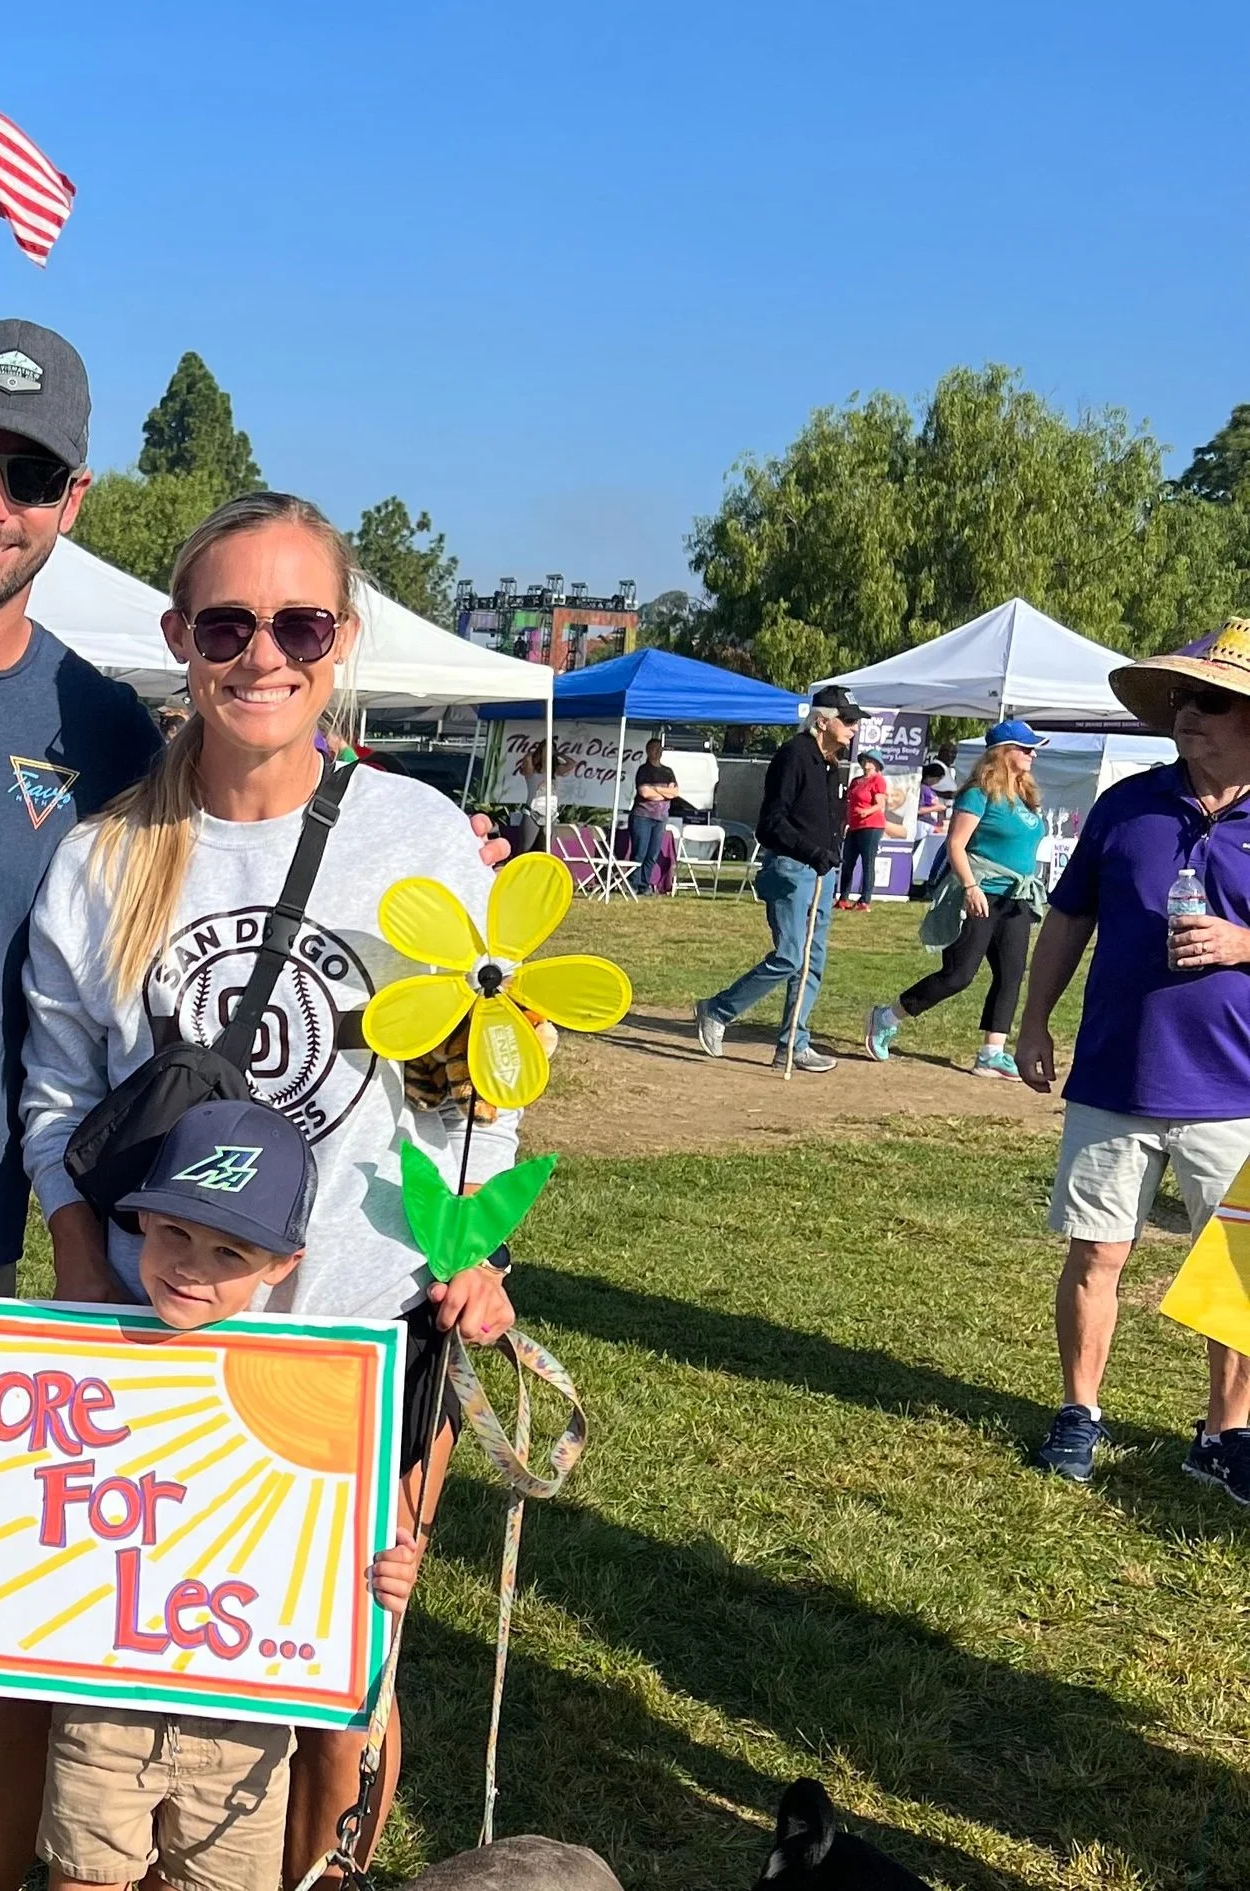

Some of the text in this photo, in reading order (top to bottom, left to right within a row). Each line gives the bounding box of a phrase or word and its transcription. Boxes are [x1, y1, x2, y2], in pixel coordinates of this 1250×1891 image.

[155, 918, 349, 990] SAN DGO
[34, 1459, 187, 1548] For
